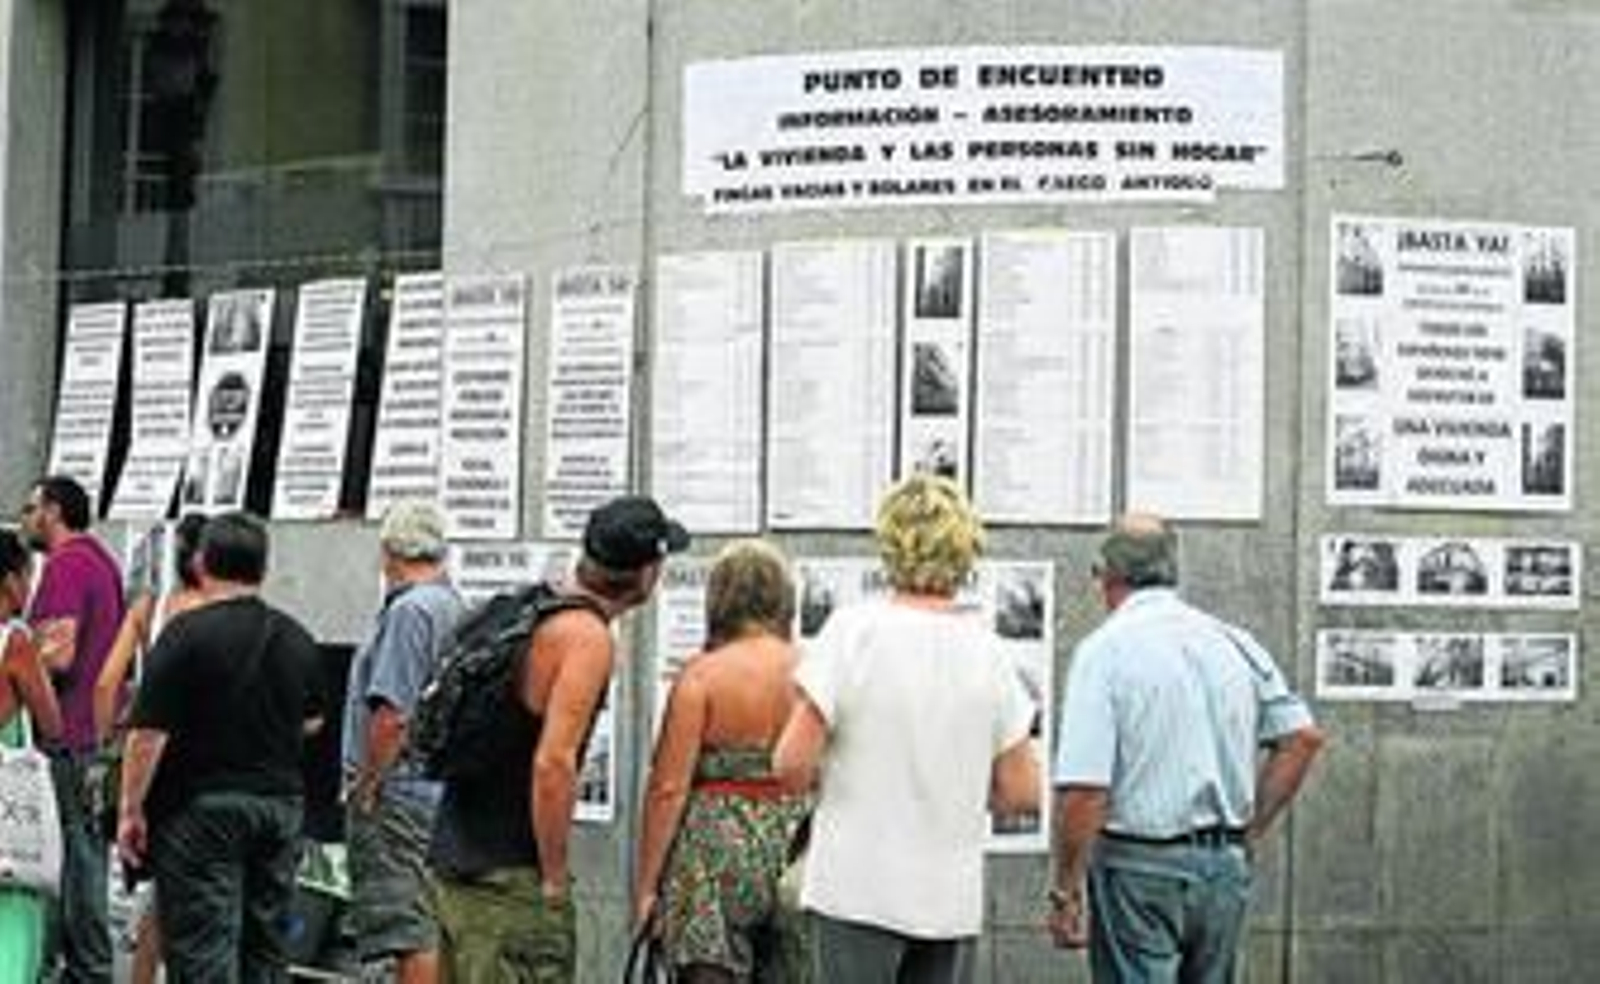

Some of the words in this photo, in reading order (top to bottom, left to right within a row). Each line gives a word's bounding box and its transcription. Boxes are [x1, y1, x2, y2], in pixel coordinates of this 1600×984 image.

[802, 68, 902, 93] PUNTO
[918, 65, 959, 90] DE
[976, 64, 1165, 89] ENCUENTRO
[776, 103, 939, 131] INFORMACIÓN
[982, 102, 1193, 124] ASESORAMIENTO
[759, 145, 867, 168] VIVIENDA
[880, 144, 896, 161] Y
[909, 141, 954, 161] LAS
[966, 140, 1099, 160] PERSONAS
[1114, 141, 1156, 161] SIN
